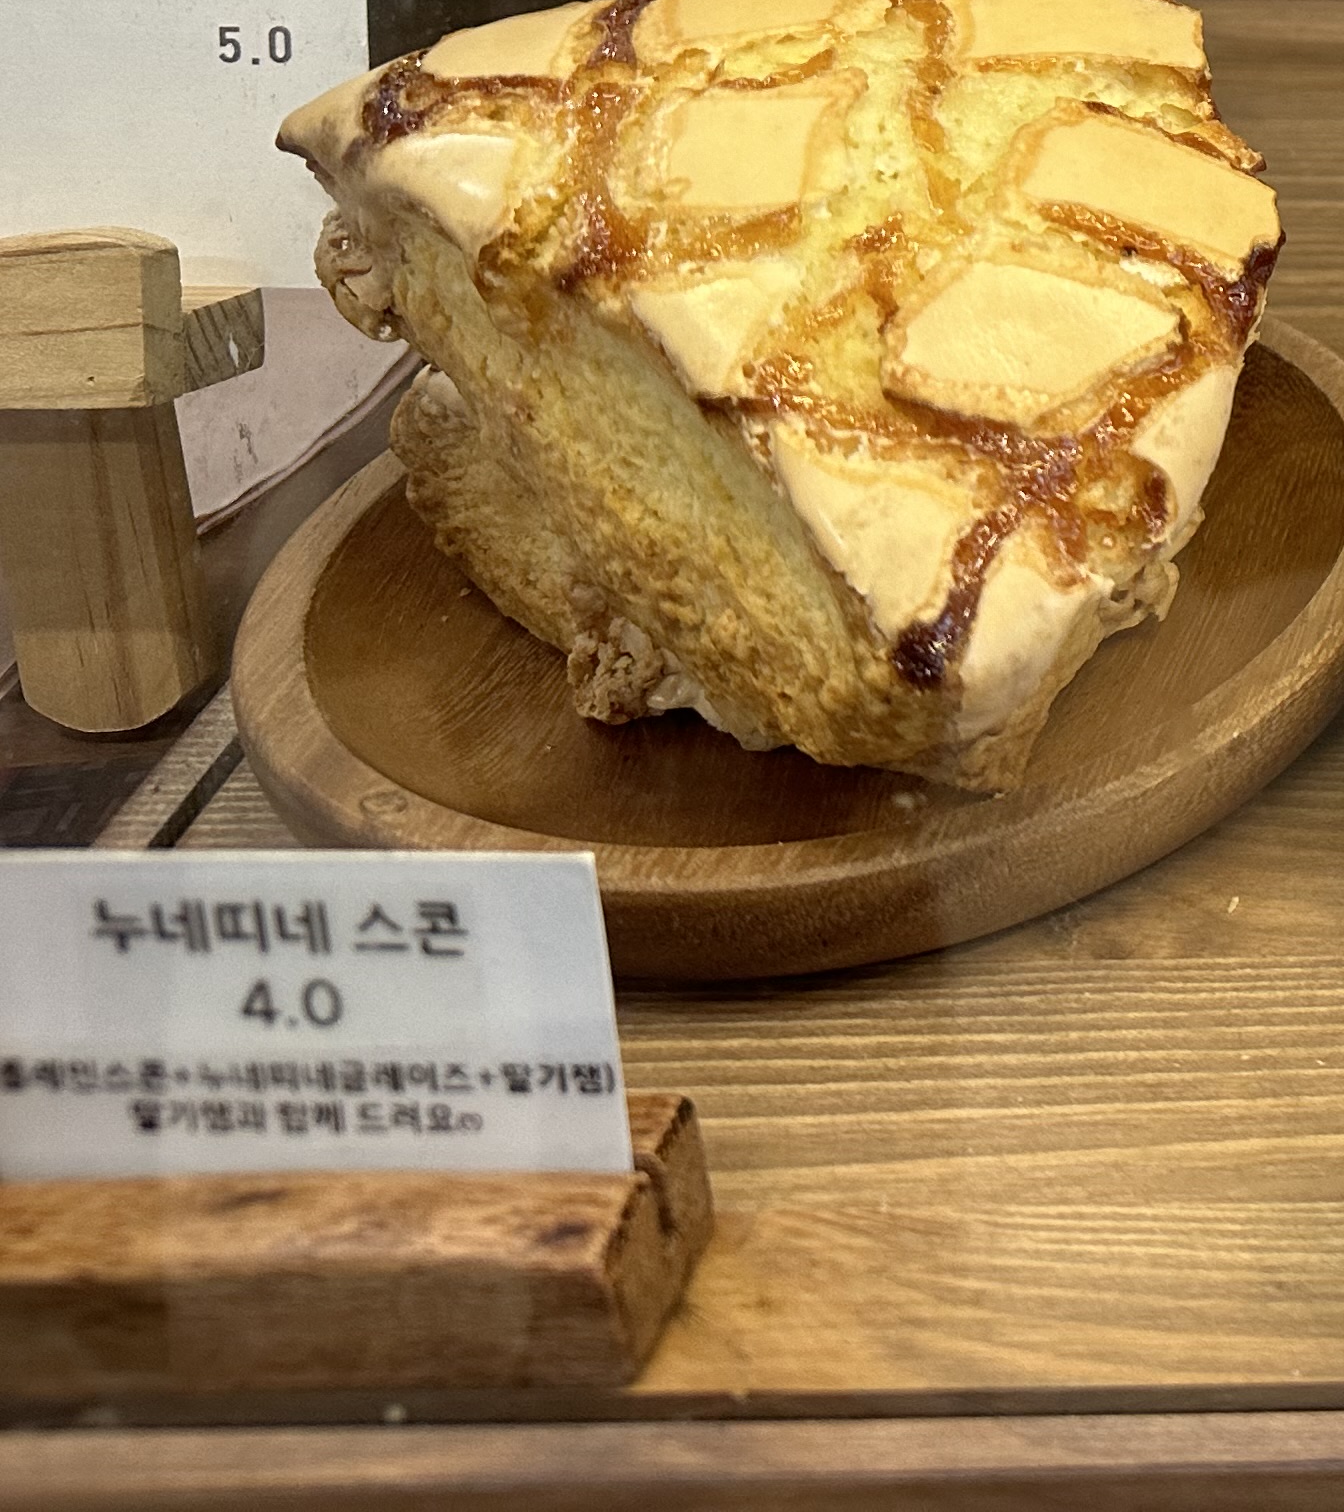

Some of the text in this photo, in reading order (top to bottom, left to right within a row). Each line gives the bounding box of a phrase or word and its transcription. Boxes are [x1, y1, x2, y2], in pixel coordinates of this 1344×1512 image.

[218, 25, 292, 66] 5.0
[93, 899, 467, 958] 누네띠네 스콘
[240, 979, 343, 1028] 4.0
